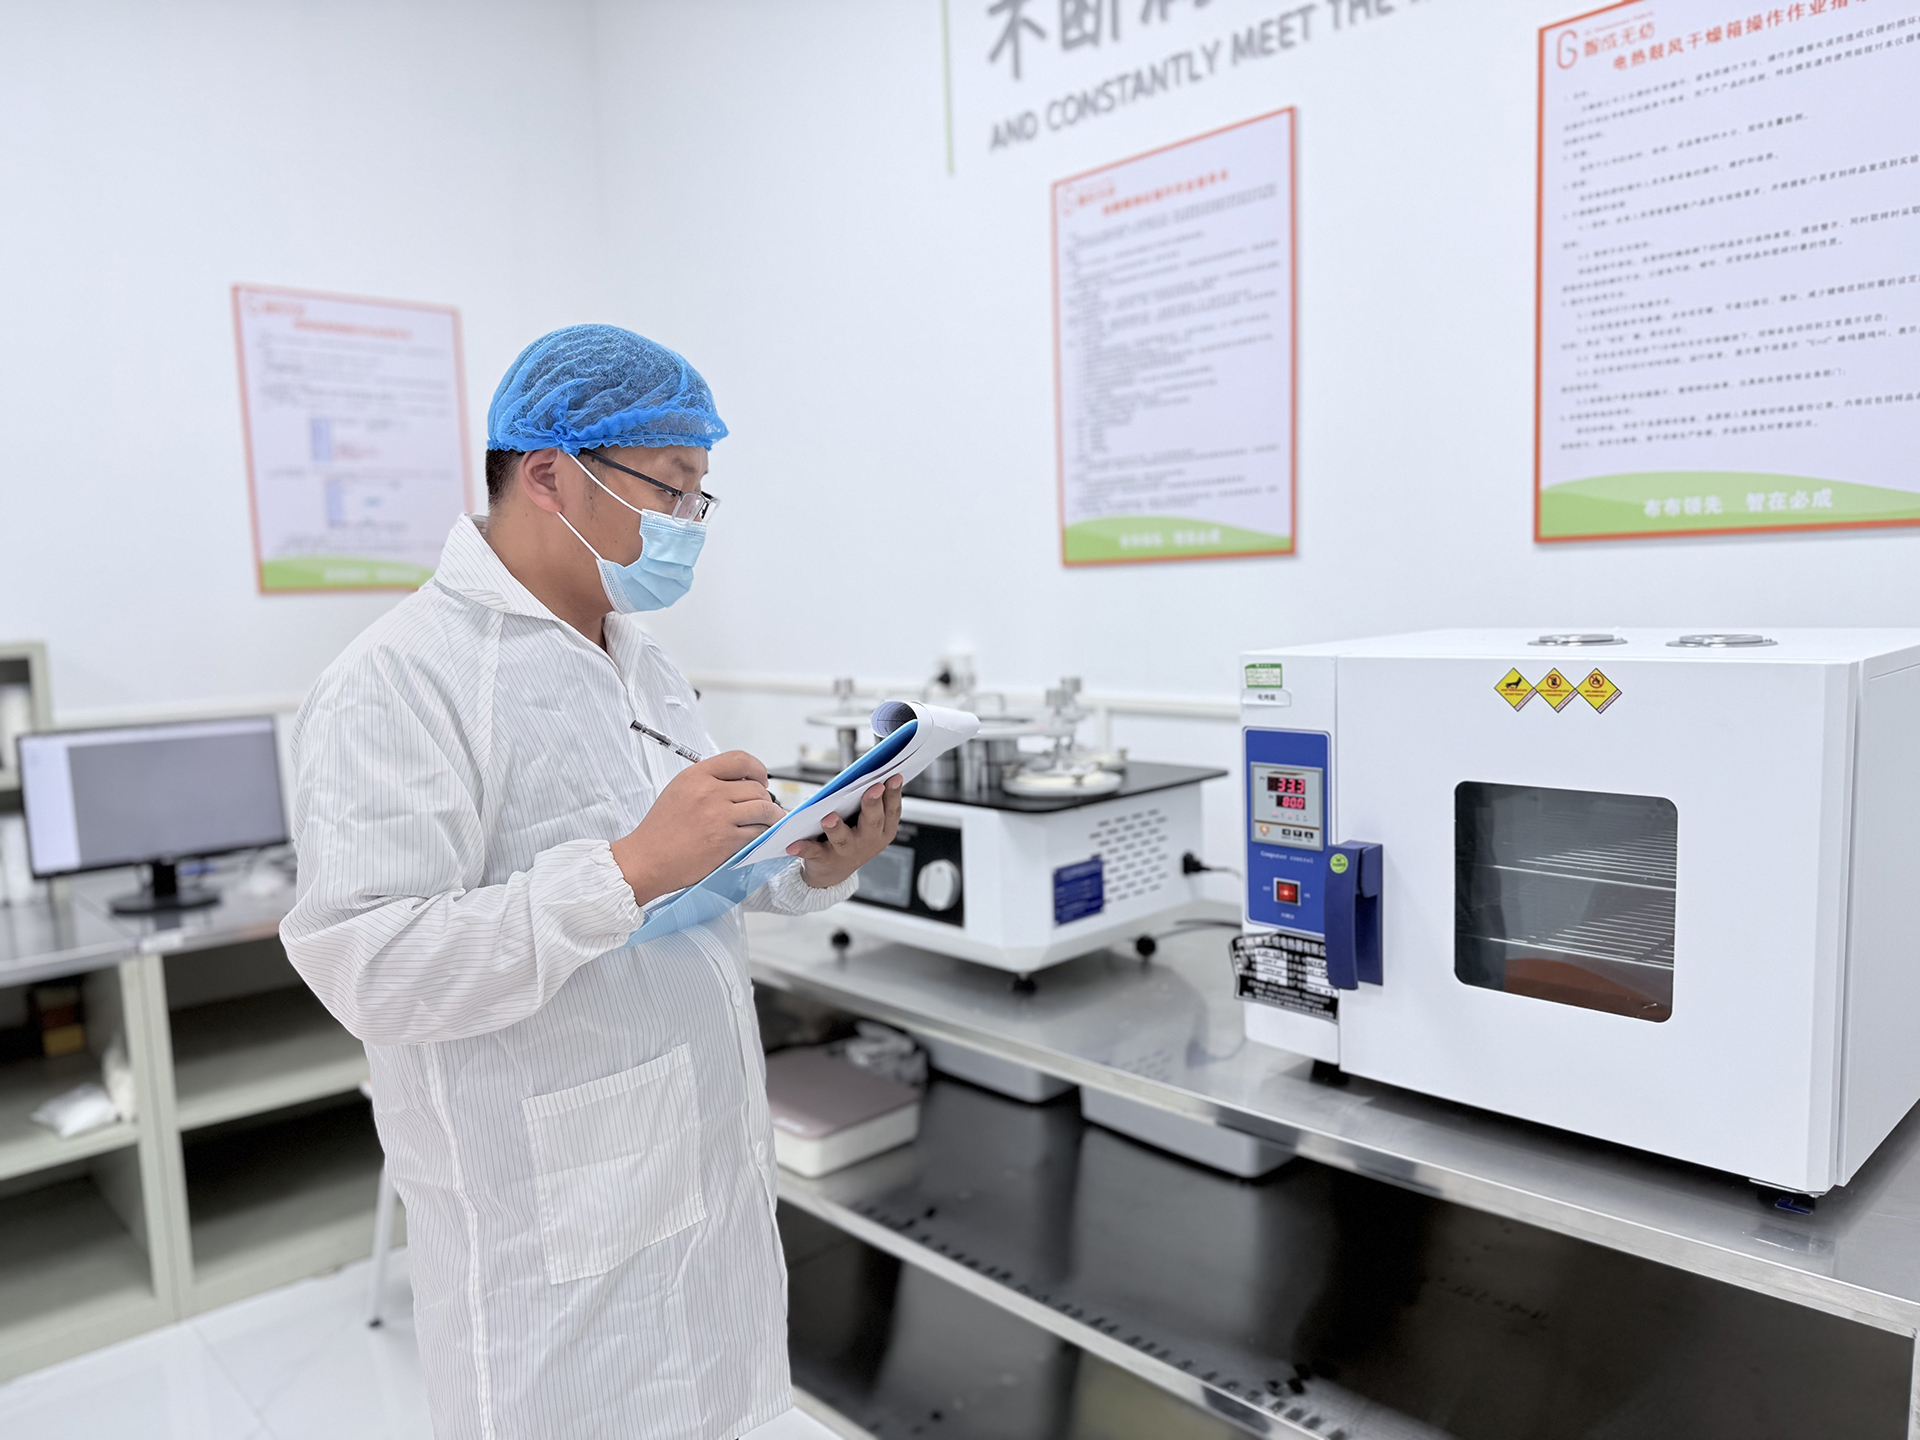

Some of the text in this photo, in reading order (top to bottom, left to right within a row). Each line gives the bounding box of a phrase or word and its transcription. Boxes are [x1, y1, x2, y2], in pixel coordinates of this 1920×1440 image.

[988, 0, 1207, 80] 不断
[1613, 0, 1867, 71] 电热鼓风干燥箱操作作业
[990, 110, 1039, 152] AND
[1045, 39, 1222, 133] CONSTANTLY
[1230, 3, 1317, 66] MEET
